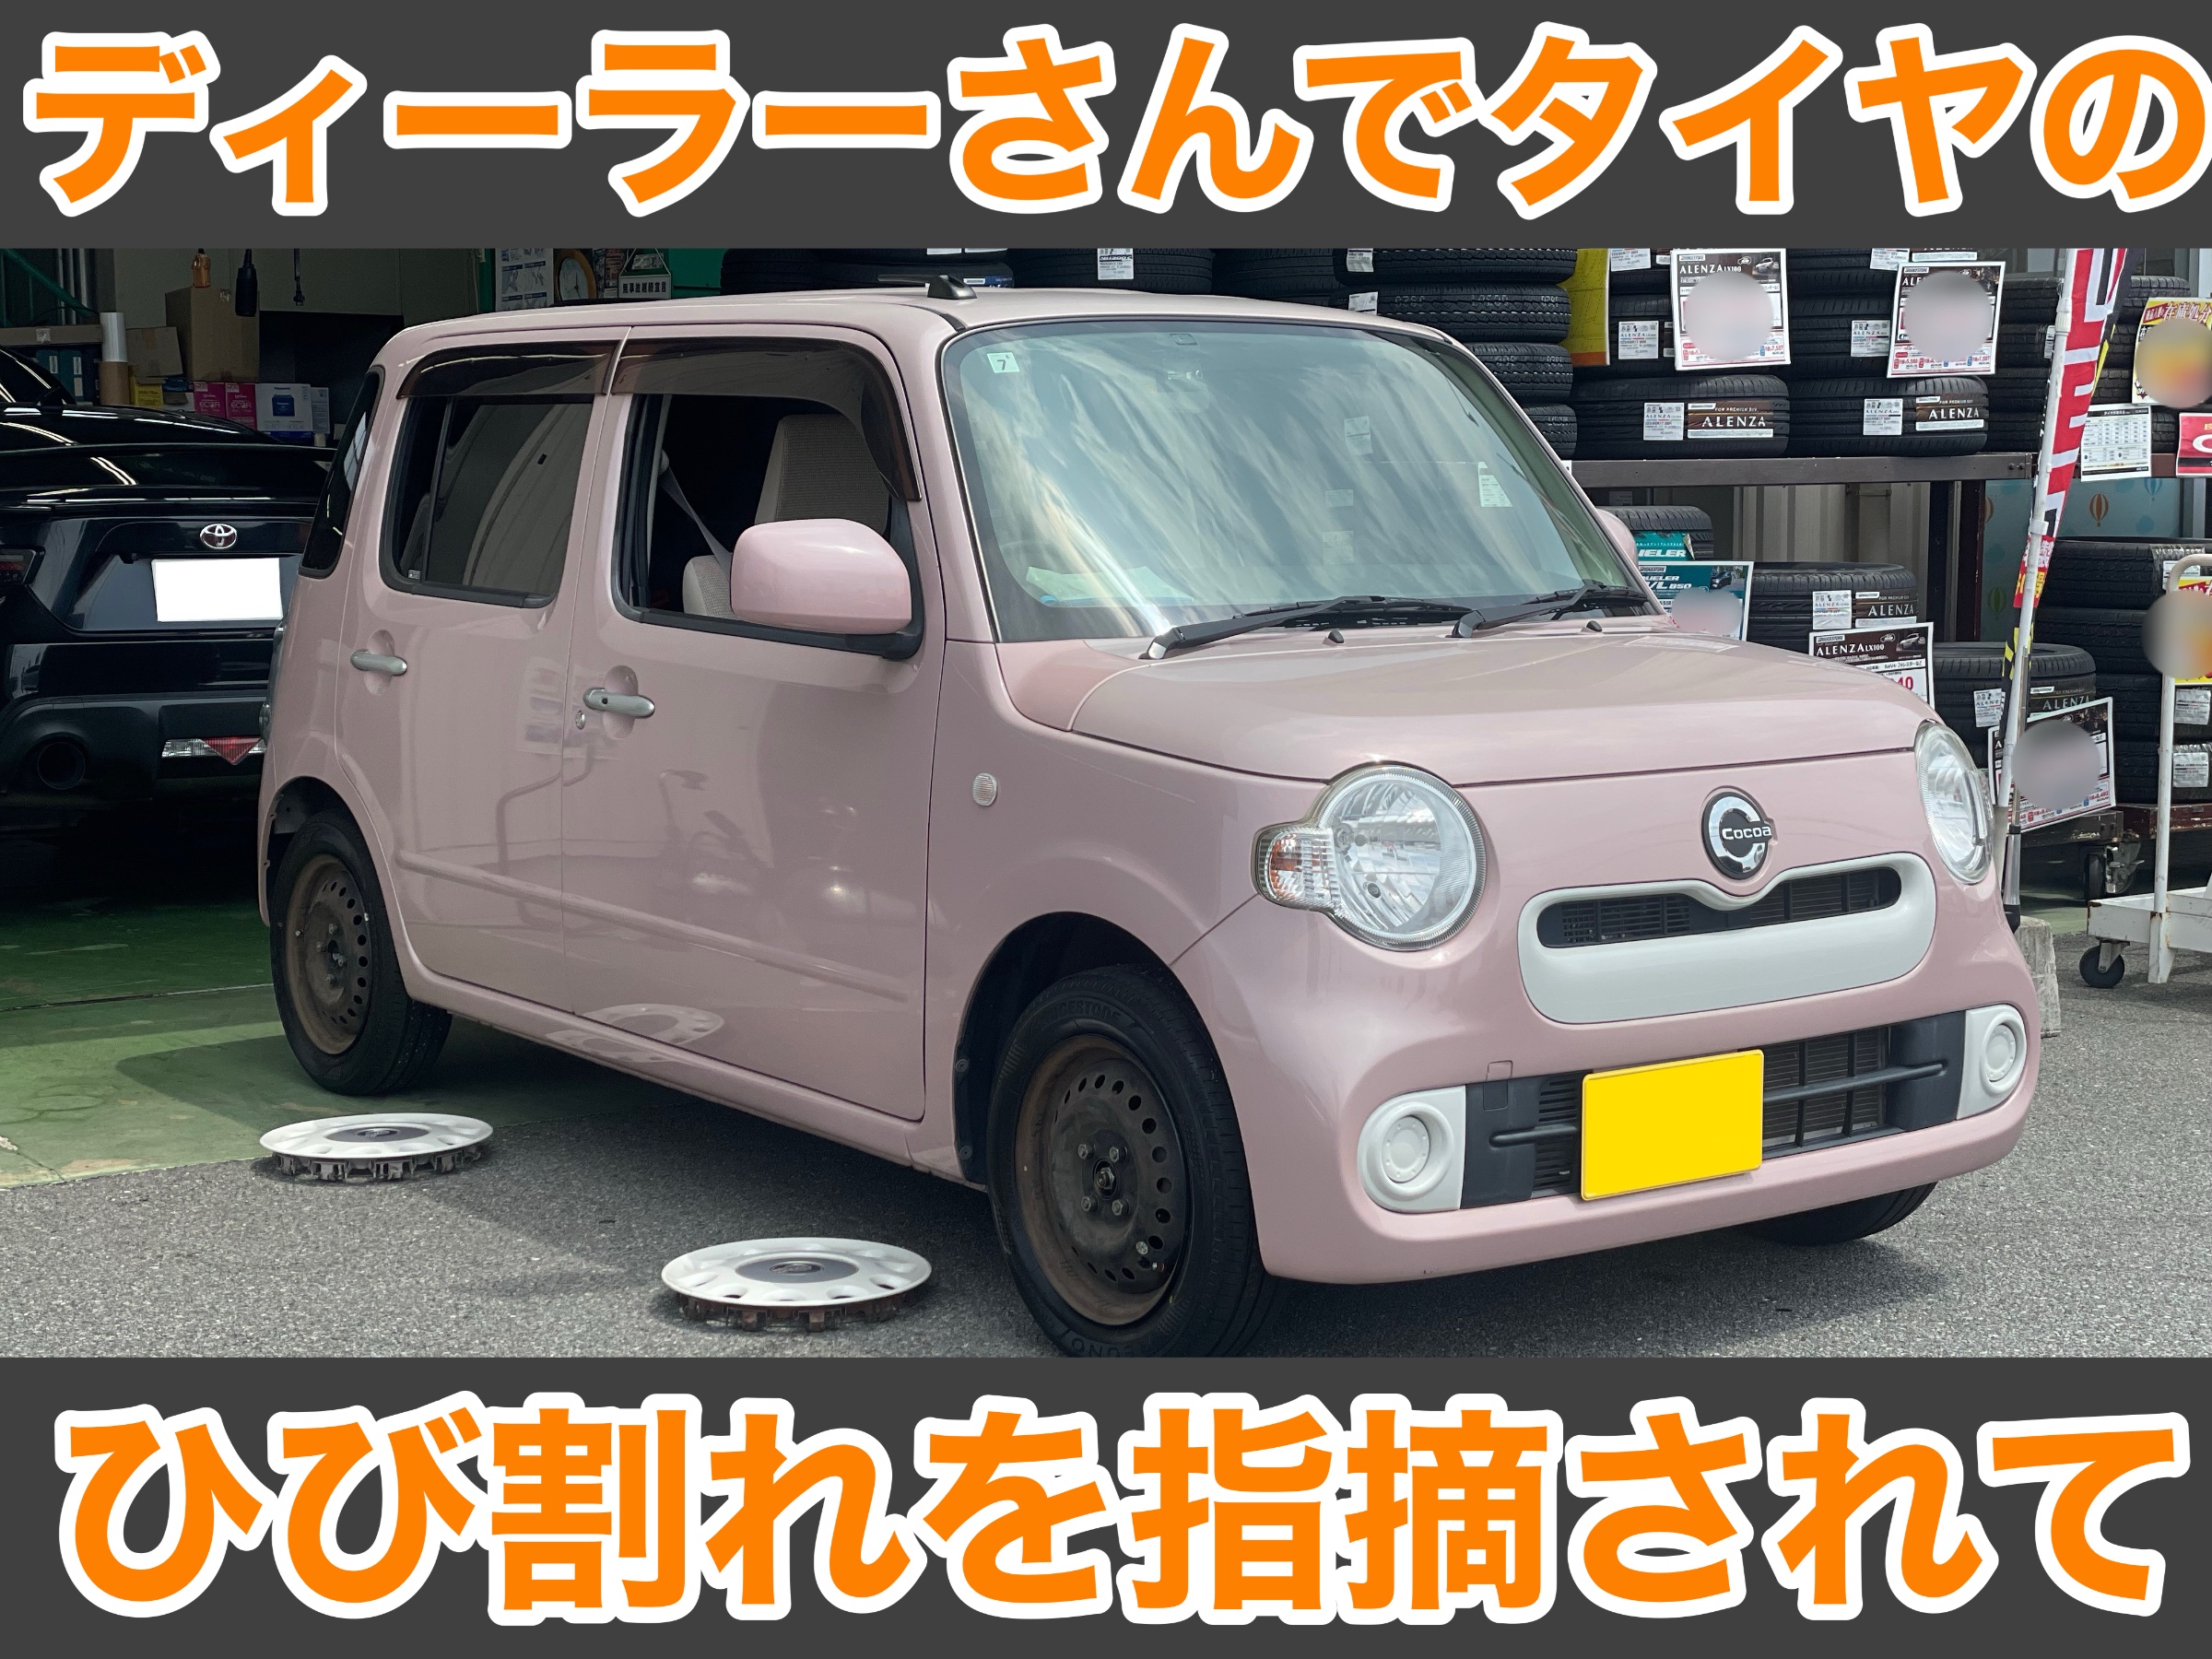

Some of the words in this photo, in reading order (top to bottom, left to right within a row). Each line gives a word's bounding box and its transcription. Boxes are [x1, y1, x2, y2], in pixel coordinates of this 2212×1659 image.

[1679, 264, 1723, 275] ALENZA
[996, 359, 1006, 371] 7
[1928, 406, 1980, 420] ALENZA
[1701, 416, 1767, 428] ALENZA
[1867, 604, 1914, 617] ALENZA
[1816, 642, 1865, 656] ALENZA
[1865, 643, 1885, 653] LX100
[1722, 826, 1772, 840] Cocoa
